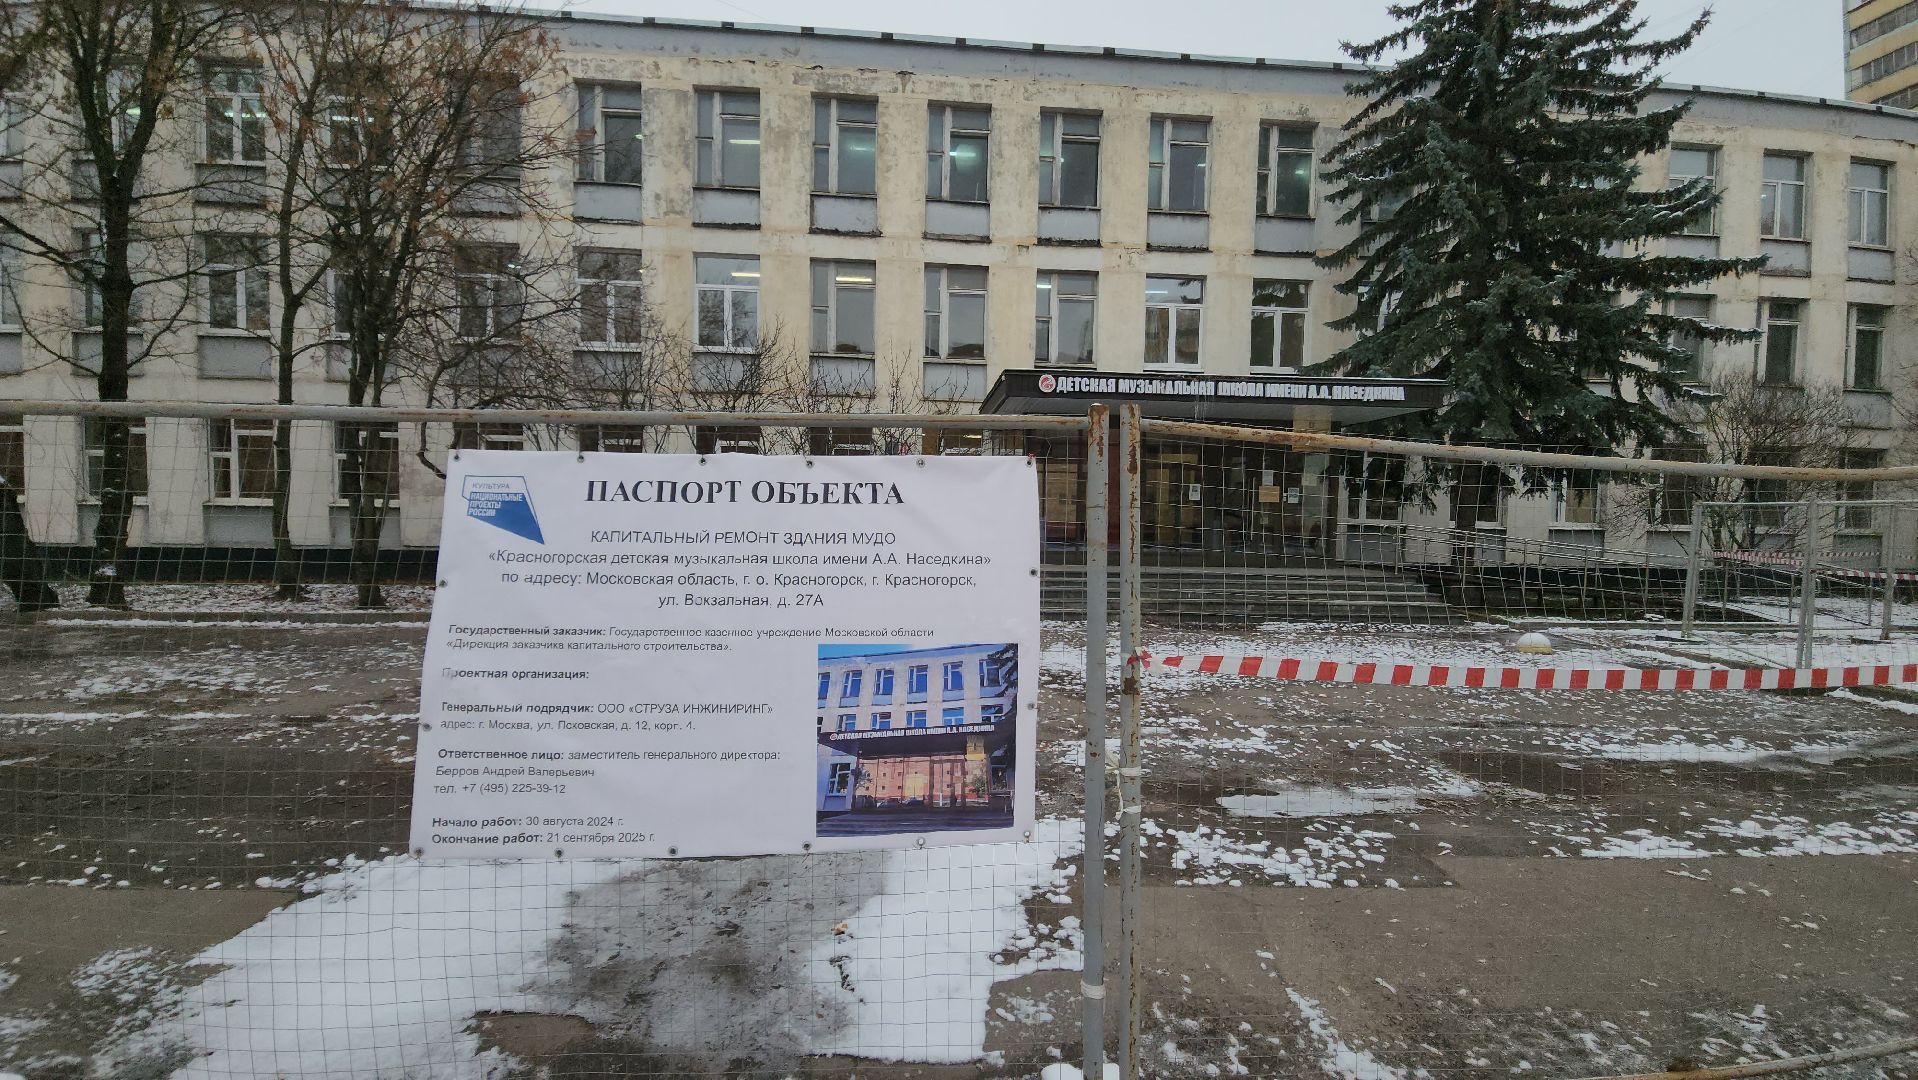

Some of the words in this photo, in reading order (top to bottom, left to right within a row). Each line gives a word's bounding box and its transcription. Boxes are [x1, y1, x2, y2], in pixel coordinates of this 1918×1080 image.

[1056, 377, 1116, 394] ДЕТСКАЯ
[1118, 378, 1215, 395] МУЗЫКАЛЬНАЯ
[1217, 381, 1264, 397] ШКОЛА
[1265, 383, 1307, 398] ИМЕНИ
[1332, 385, 1405, 401] НАСЕДКИНА
[584, 480, 742, 504] ПАСПОРТ
[751, 480, 905, 505] ОБЪЕКТА
[469, 501, 501, 509] ПРОЕКТЫ
[468, 508, 496, 516] РОССИИ
[591, 530, 710, 544] КАПИТАЛЬНЫЙ
[714, 531, 779, 544] РЕМОНТ
[783, 532, 847, 546] ЗДАНИЯ
[852, 532, 896, 546] МУДО
[488, 549, 607, 565] «Красногорская
[610, 552, 669, 565] детская
[674, 554, 768, 567] музыкальная
[772, 555, 818, 565] школа
[823, 555, 868, 565] имени
[872, 552, 901, 565] А.А.
[906, 552, 991, 567] Наседкина»
[501, 573, 519, 583] по
[523, 573, 582, 587] адресу:
[586, 572, 674, 586] Московская
[677, 573, 738, 587] область,
[743, 575, 751, 585] г.
[756, 575, 769, 585] о.
[774, 573, 867, 588] Красногорск,
[872, 575, 879, 585] г.
[885, 573, 977, 588] Красногорск,
[657, 597, 680, 609] ул.
[777, 597, 791, 608] д.
[795, 594, 824, 606] 27А
[448, 625, 550, 637] Государственный
[552, 626, 607, 636] заказчик:
[825, 627, 888, 637] Московской
[890, 628, 935, 637] области
[446, 639, 509, 650] «Дирекция
[643, 641, 733, 653] строительства».
[511, 670, 590, 681] организация:
[442, 702, 523, 714] Генеральный
[526, 703, 594, 716] подрядчик:
[597, 703, 626, 714] ООО
[628, 703, 680, 714] «СТРУЗА
[683, 703, 773, 714] ИНЖИНИРИНГ»
[440, 719, 475, 730] адрес:
[488, 719, 533, 731] Москва,
[537, 721, 554, 732] ул.
[557, 720, 618, 731] Псковская,
[620, 722, 632, 731] д.
[635, 721, 651, 731] 12,
[437, 748, 528, 760] Ответственное
[530, 750, 564, 762] лицо:
[567, 750, 641, 761] заместитель
[643, 751, 718, 762] генерального
[720, 751, 781, 762] директора:
[482, 766, 525, 777] Андрей
[528, 767, 595, 778] Валерьевич
[434, 783, 457, 794] тел.
[462, 784, 477, 793] +7
[479, 783, 508, 795] (495)
[511, 783, 566, 794] 225-39-12
[432, 817, 478, 828] Начало
[481, 816, 522, 829] работ:
[525, 816, 540, 826] 30
[542, 818, 584, 827] августа
[586, 816, 614, 827] 2024
[432, 833, 499, 845] Окончание
[502, 832, 544, 845] работ:
[546, 833, 560, 844] 21
[563, 832, 615, 844] сентября
[618, 832, 646, 843] 2025
